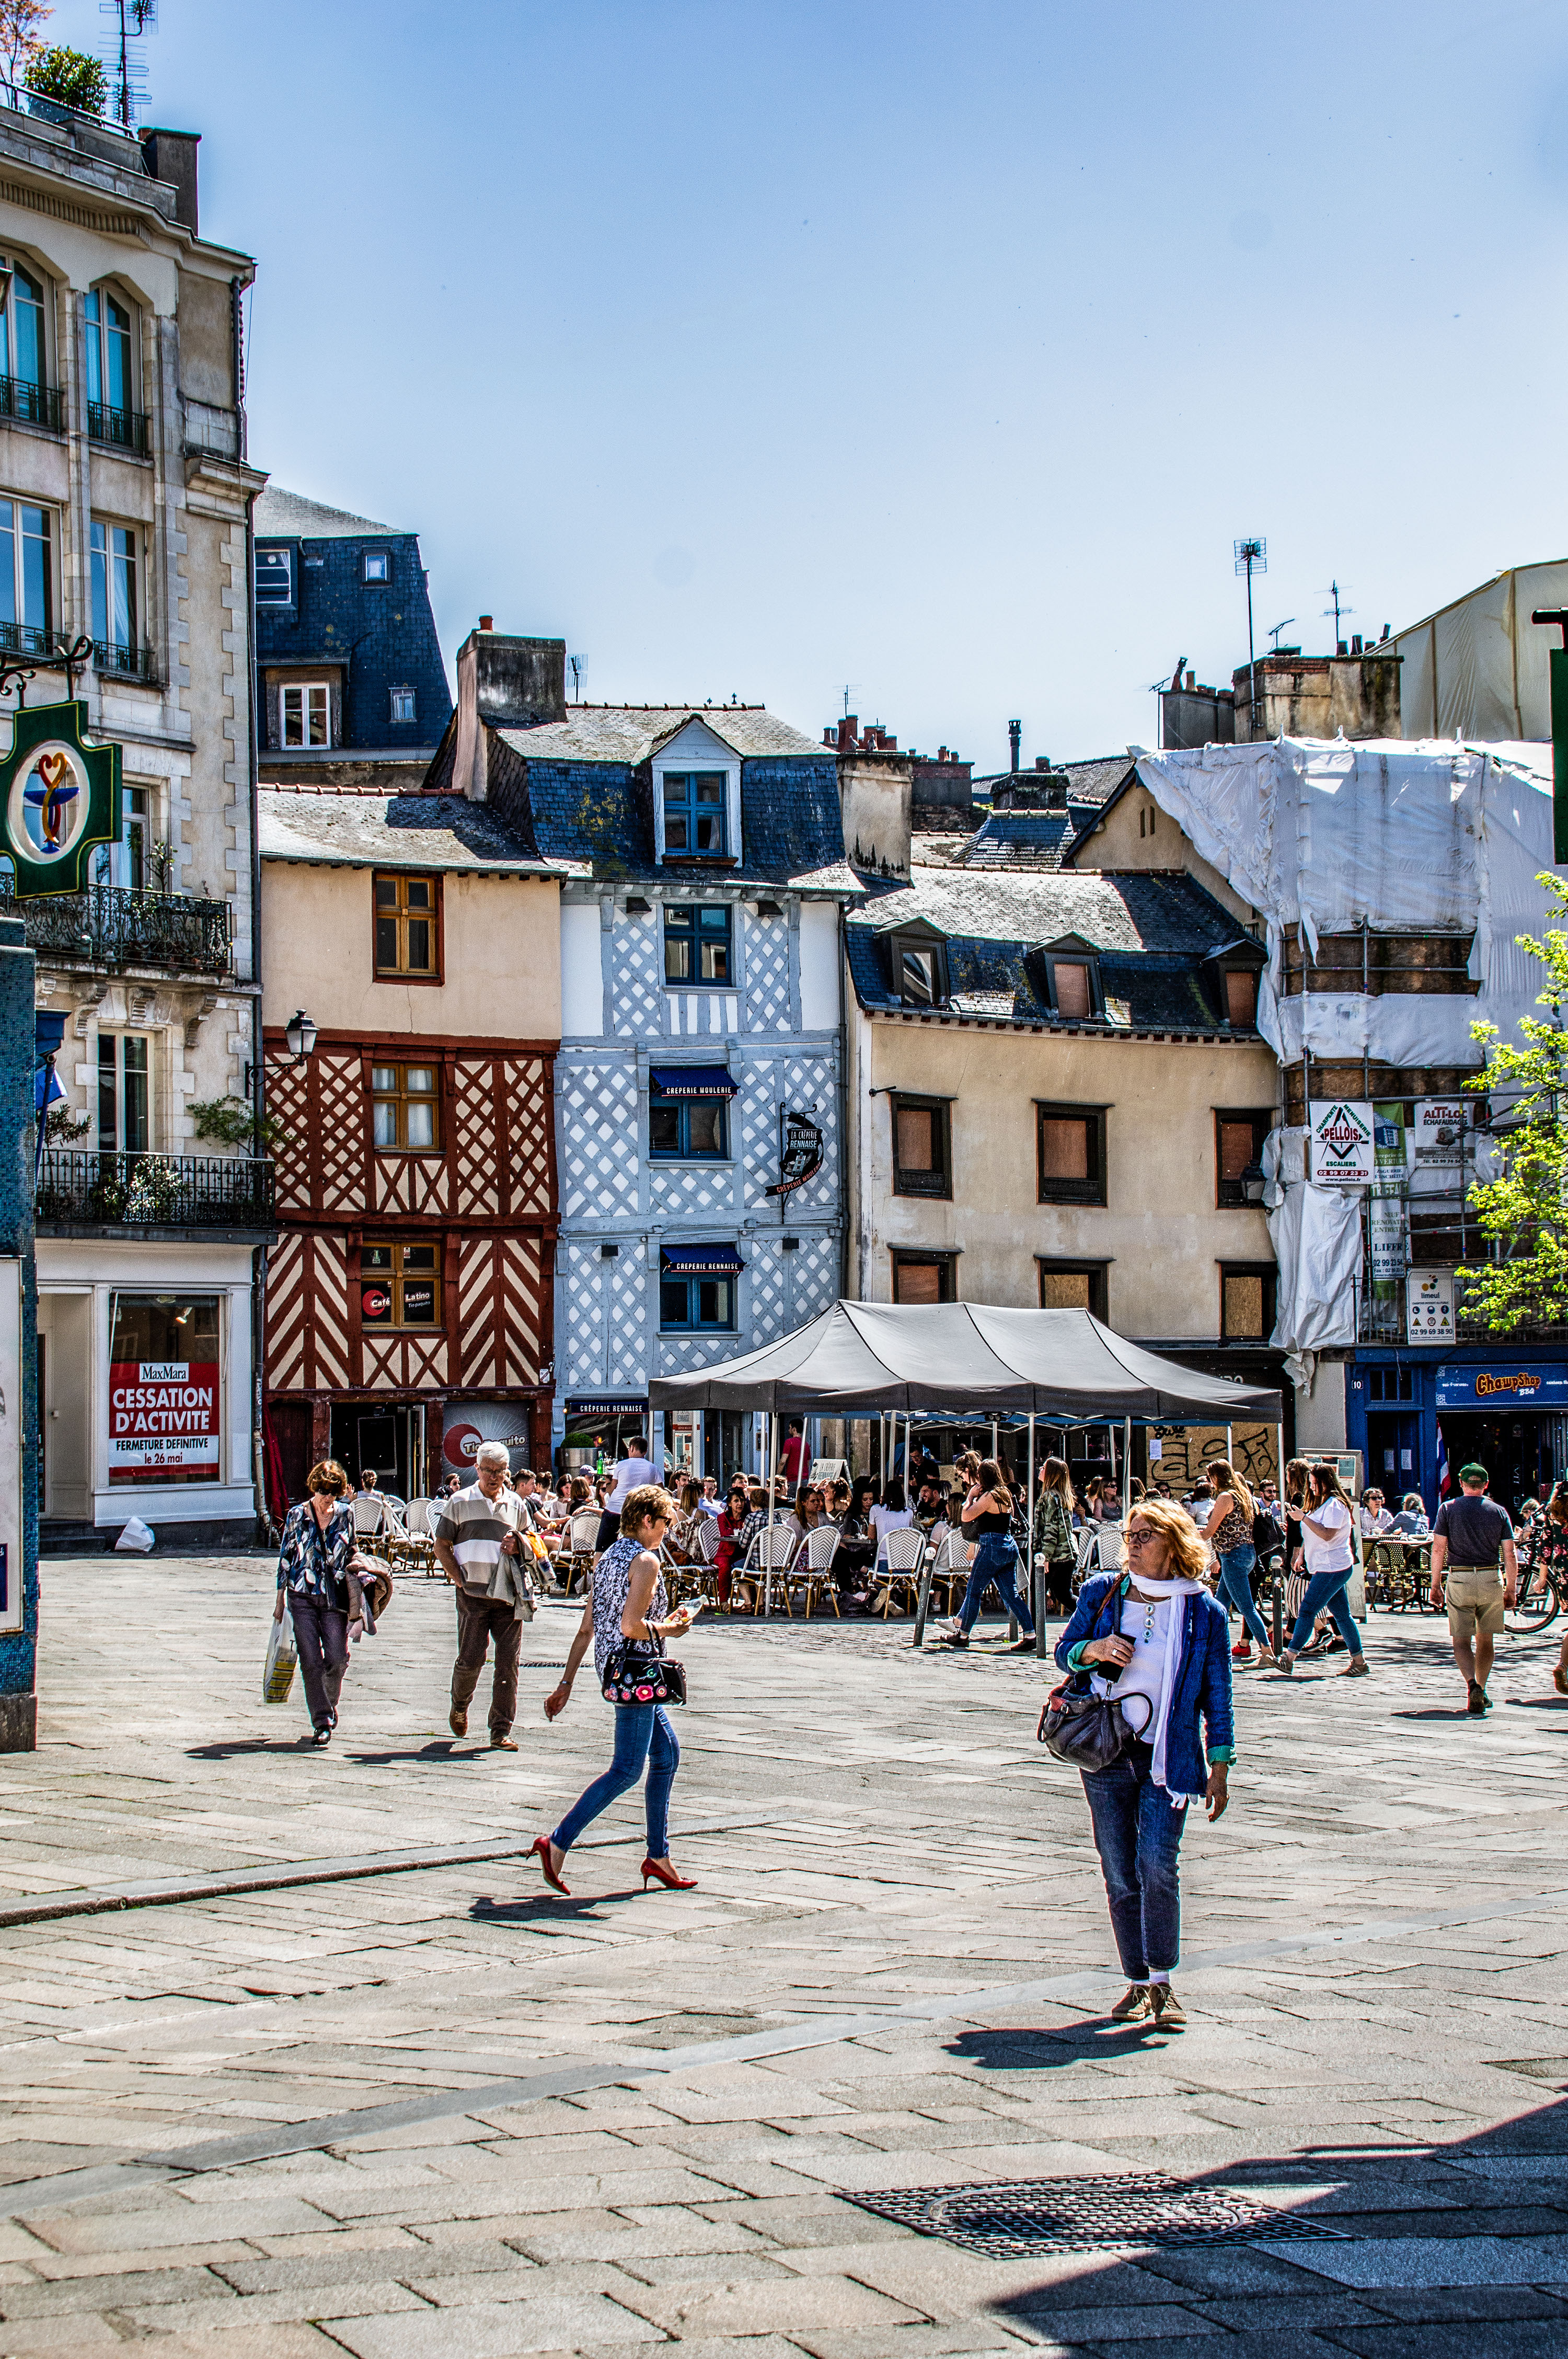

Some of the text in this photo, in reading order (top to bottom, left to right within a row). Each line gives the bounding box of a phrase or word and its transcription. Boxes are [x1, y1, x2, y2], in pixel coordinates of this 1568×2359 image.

[1316, 1105, 1338, 1133] CHARPENTE
[1343, 1104, 1371, 1137] MENUISERIE
[791, 1130, 817, 1139] LA CRÊPERIE
[1324, 1126, 1358, 1141] PELLOIS
[790, 1140, 817, 1148] RENNAISE
[776, 1161, 822, 1193] CRÊPERIE MOULERIE
[371, 1297, 391, 1308] Café
[405, 1292, 430, 1302] Latino
[142, 1365, 187, 1380] MaxMara
[113, 1387, 212, 1409] CESSATION
[1519, 1388, 1535, 1396] BBQ
[116, 1410, 210, 1432] D'ACTIVITE
[116, 1438, 208, 1451] FERMETURE DEFINITIVE
[145, 1452, 183, 1464] le 26 mai
